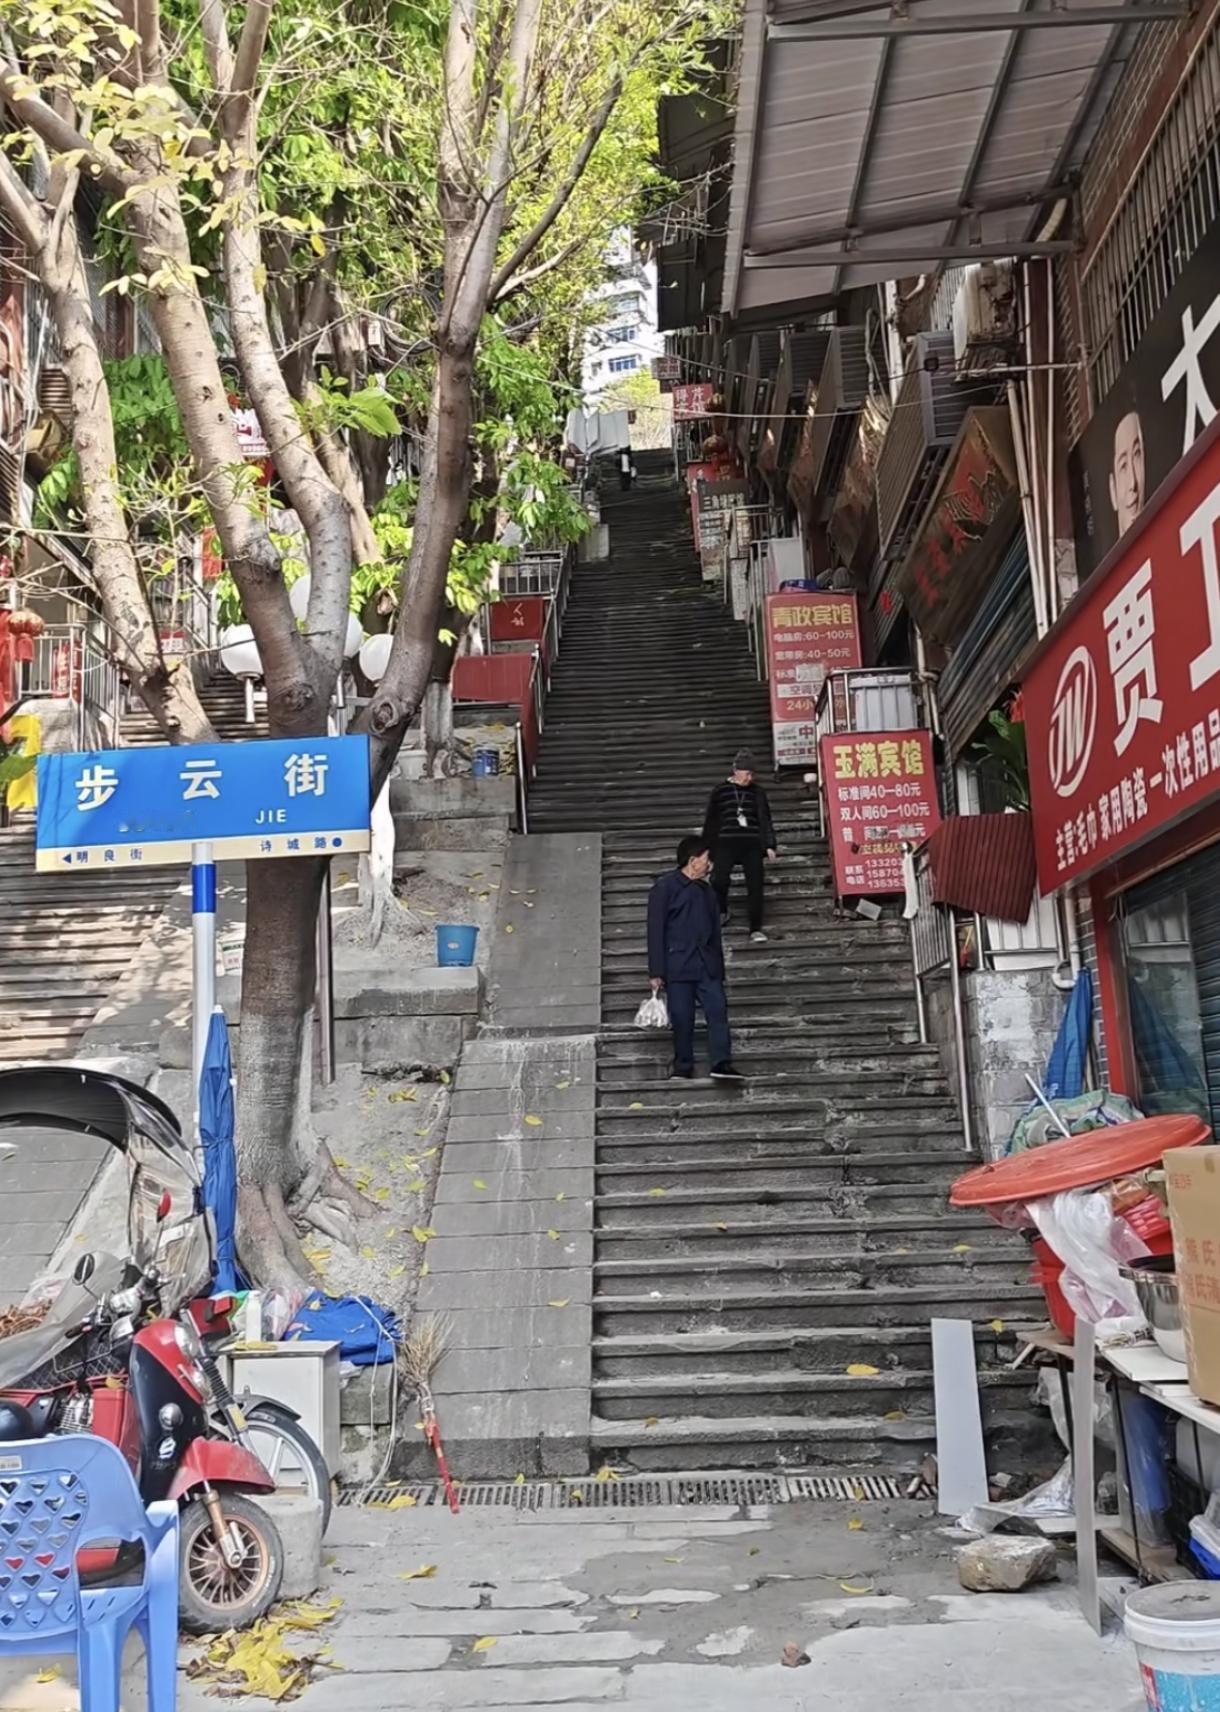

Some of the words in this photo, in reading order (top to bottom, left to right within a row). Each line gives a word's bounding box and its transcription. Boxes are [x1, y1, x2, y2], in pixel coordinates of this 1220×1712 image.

[75, 753, 328, 812] 步云街
[255, 809, 287, 825] JIE
